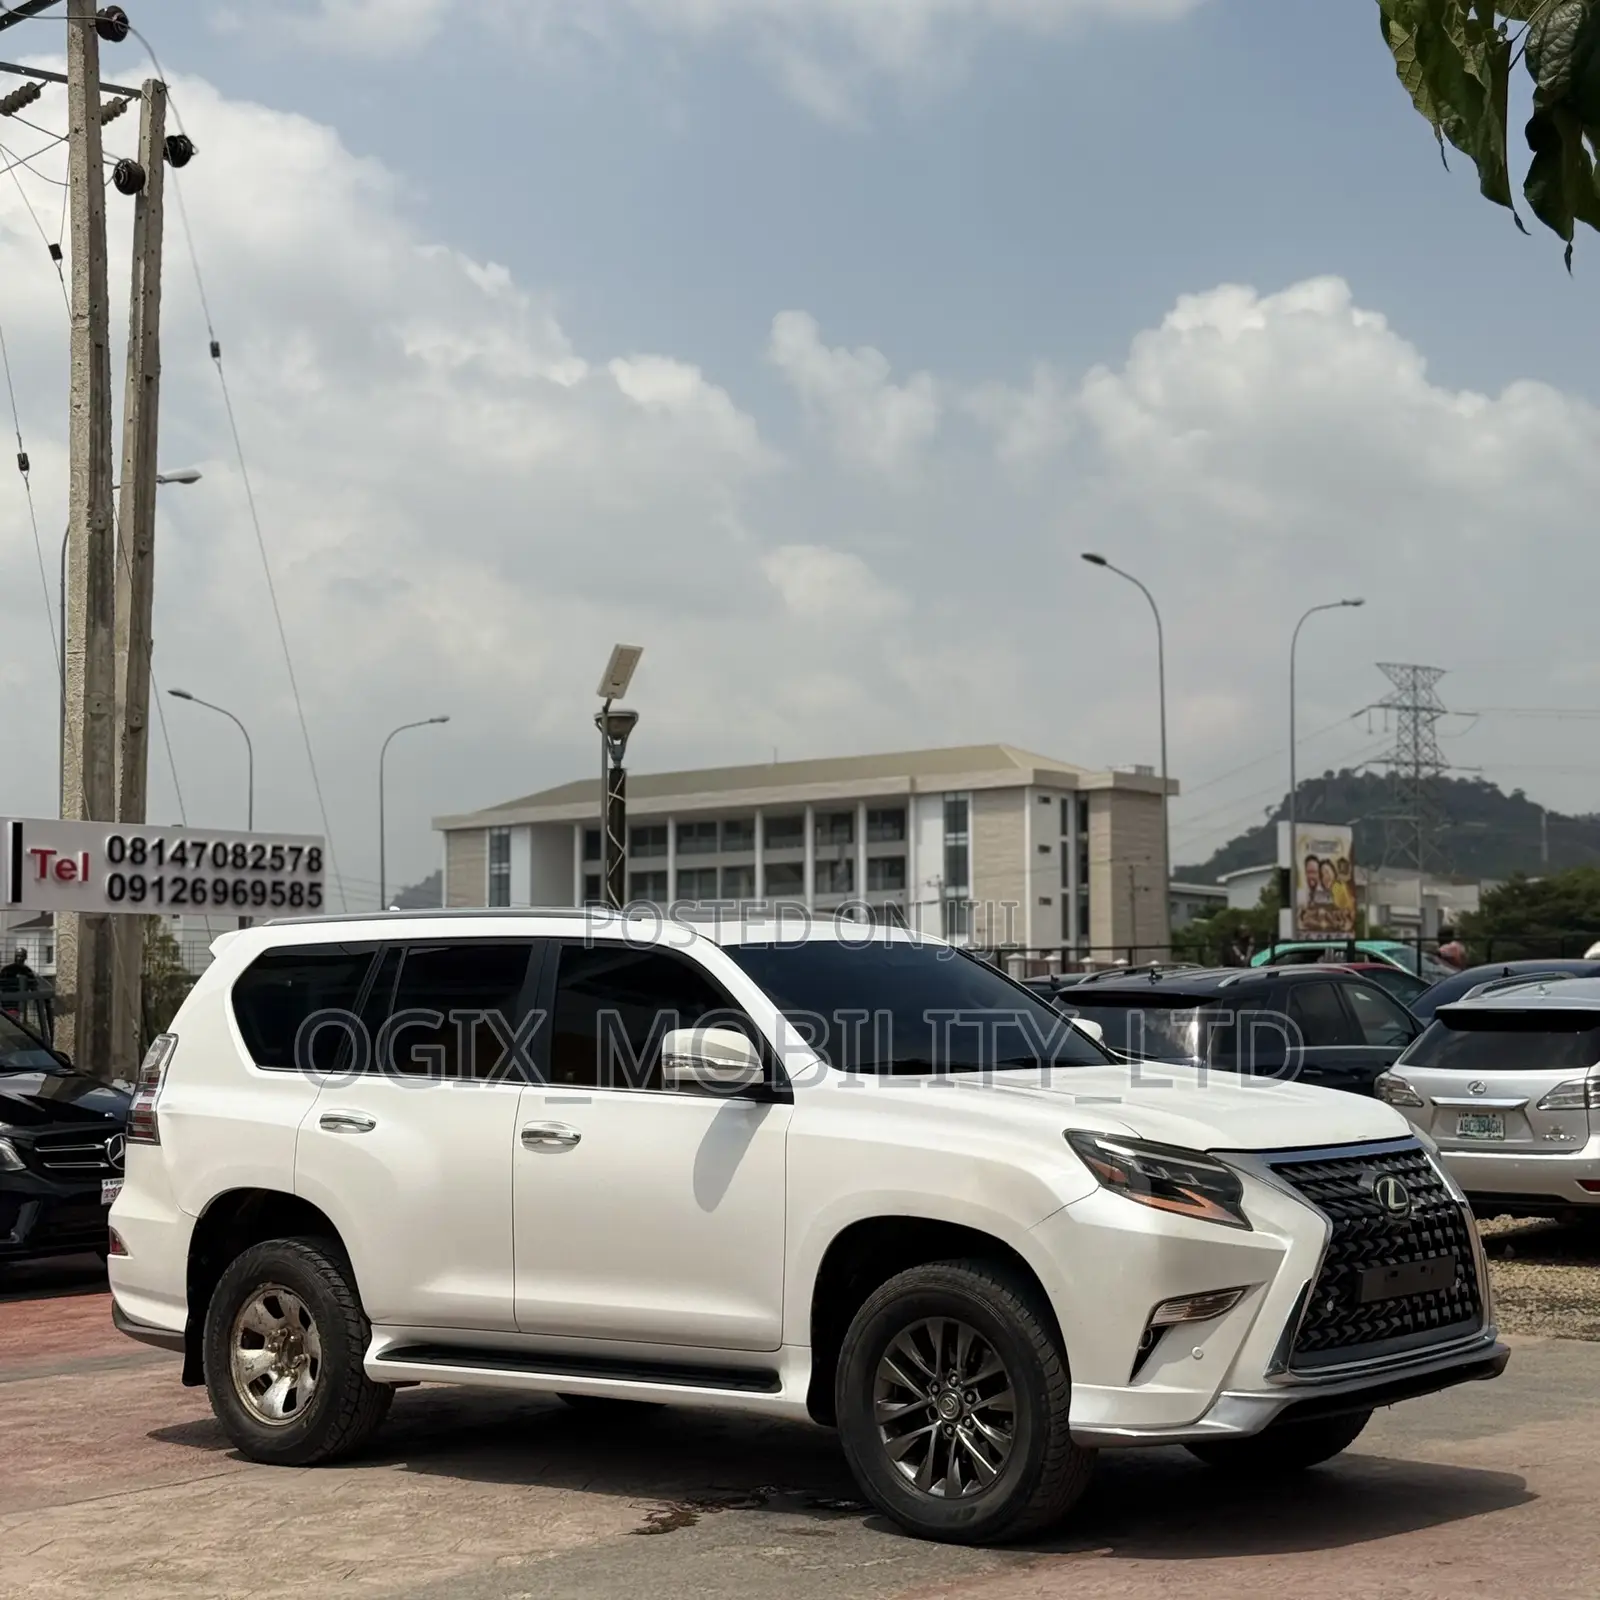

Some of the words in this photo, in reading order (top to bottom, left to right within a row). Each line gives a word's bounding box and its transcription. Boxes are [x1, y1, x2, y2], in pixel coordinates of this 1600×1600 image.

[29, 848, 90, 882] Tel
[106, 835, 323, 873] 08147082578
[106, 873, 323, 908] 09126969585
